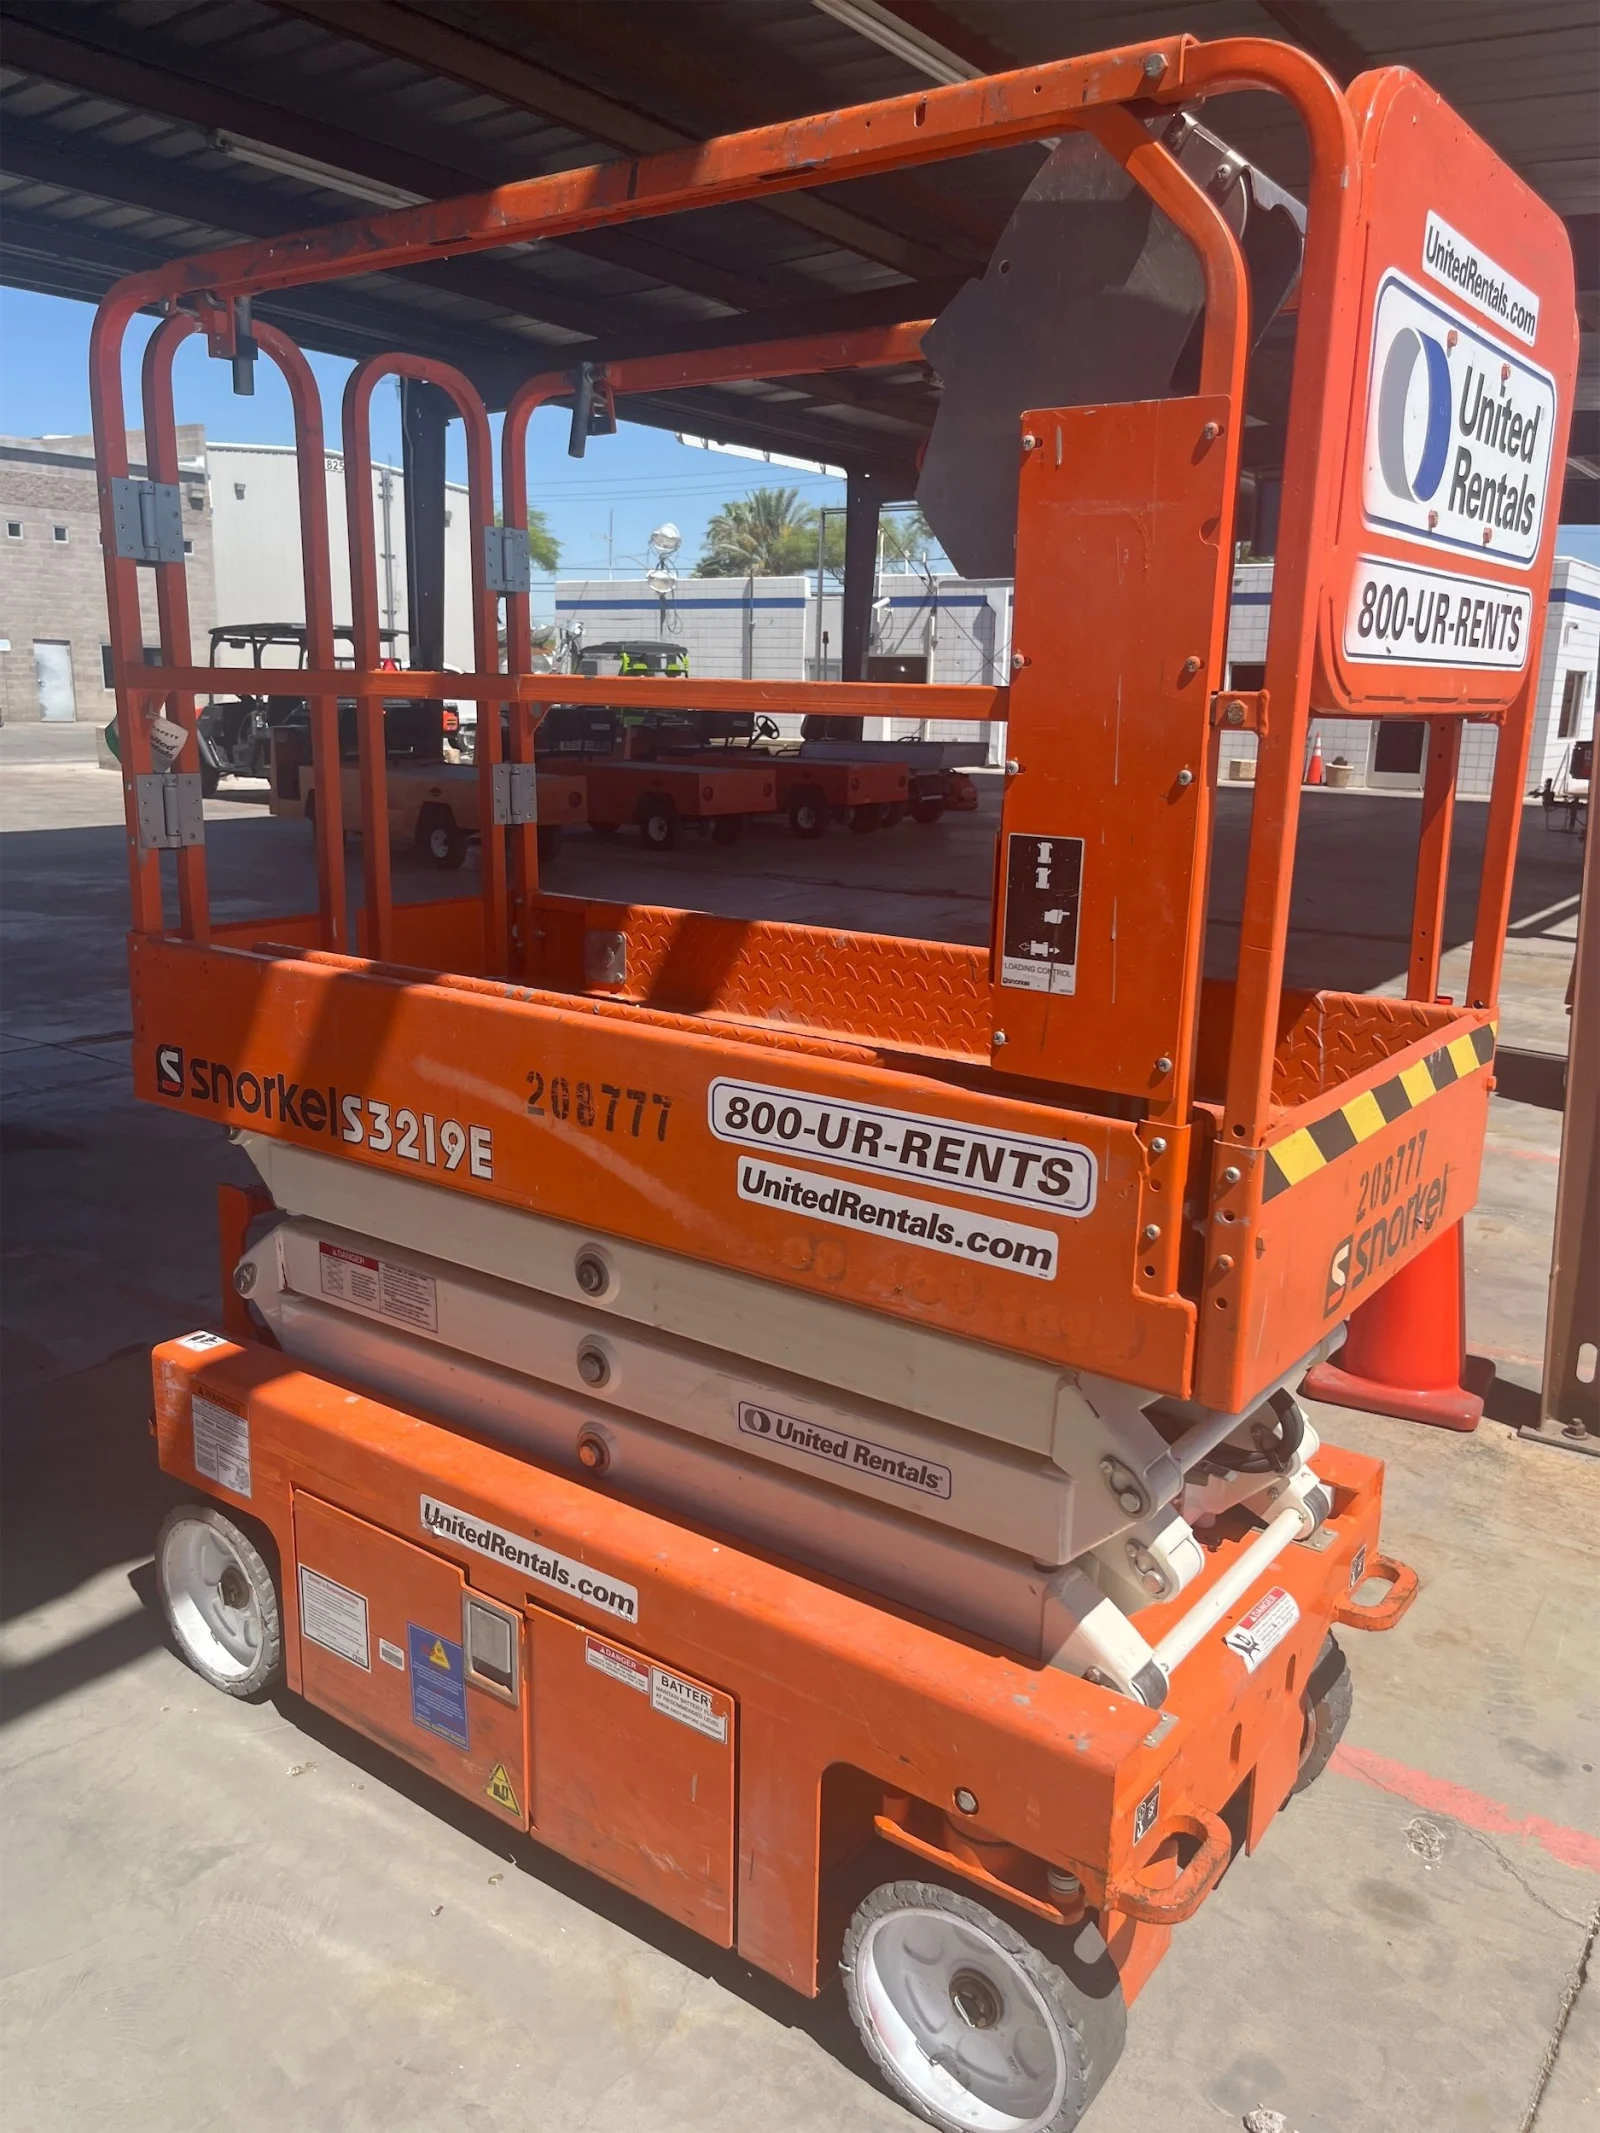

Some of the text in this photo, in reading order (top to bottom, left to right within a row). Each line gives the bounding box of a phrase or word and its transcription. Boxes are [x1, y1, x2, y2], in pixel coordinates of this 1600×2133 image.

[1426, 225, 1535, 337] UnitedRentals.com
[1459, 365, 1541, 464] United
[1448, 445, 1535, 535] Rentals
[1358, 581, 1522, 652] 800-UR-RENTS
[1004, 963, 1071, 978] LOADING CONTROL
[190, 1057, 338, 1137] snorkel
[342, 1094, 493, 1181] S3219E
[526, 1070, 673, 1142] 208777
[725, 1096, 1074, 1197] 800-UR-RENTS
[742, 1165, 1052, 1271] UnitedRentals.com
[1356, 1128, 1428, 1225] 208777
[1351, 1162, 1449, 1290] snorkel
[776, 1418, 940, 1490] United Rentals
[424, 1502, 635, 1616] UnitedRentals.com
[605, 1649, 637, 1669] DANGER
